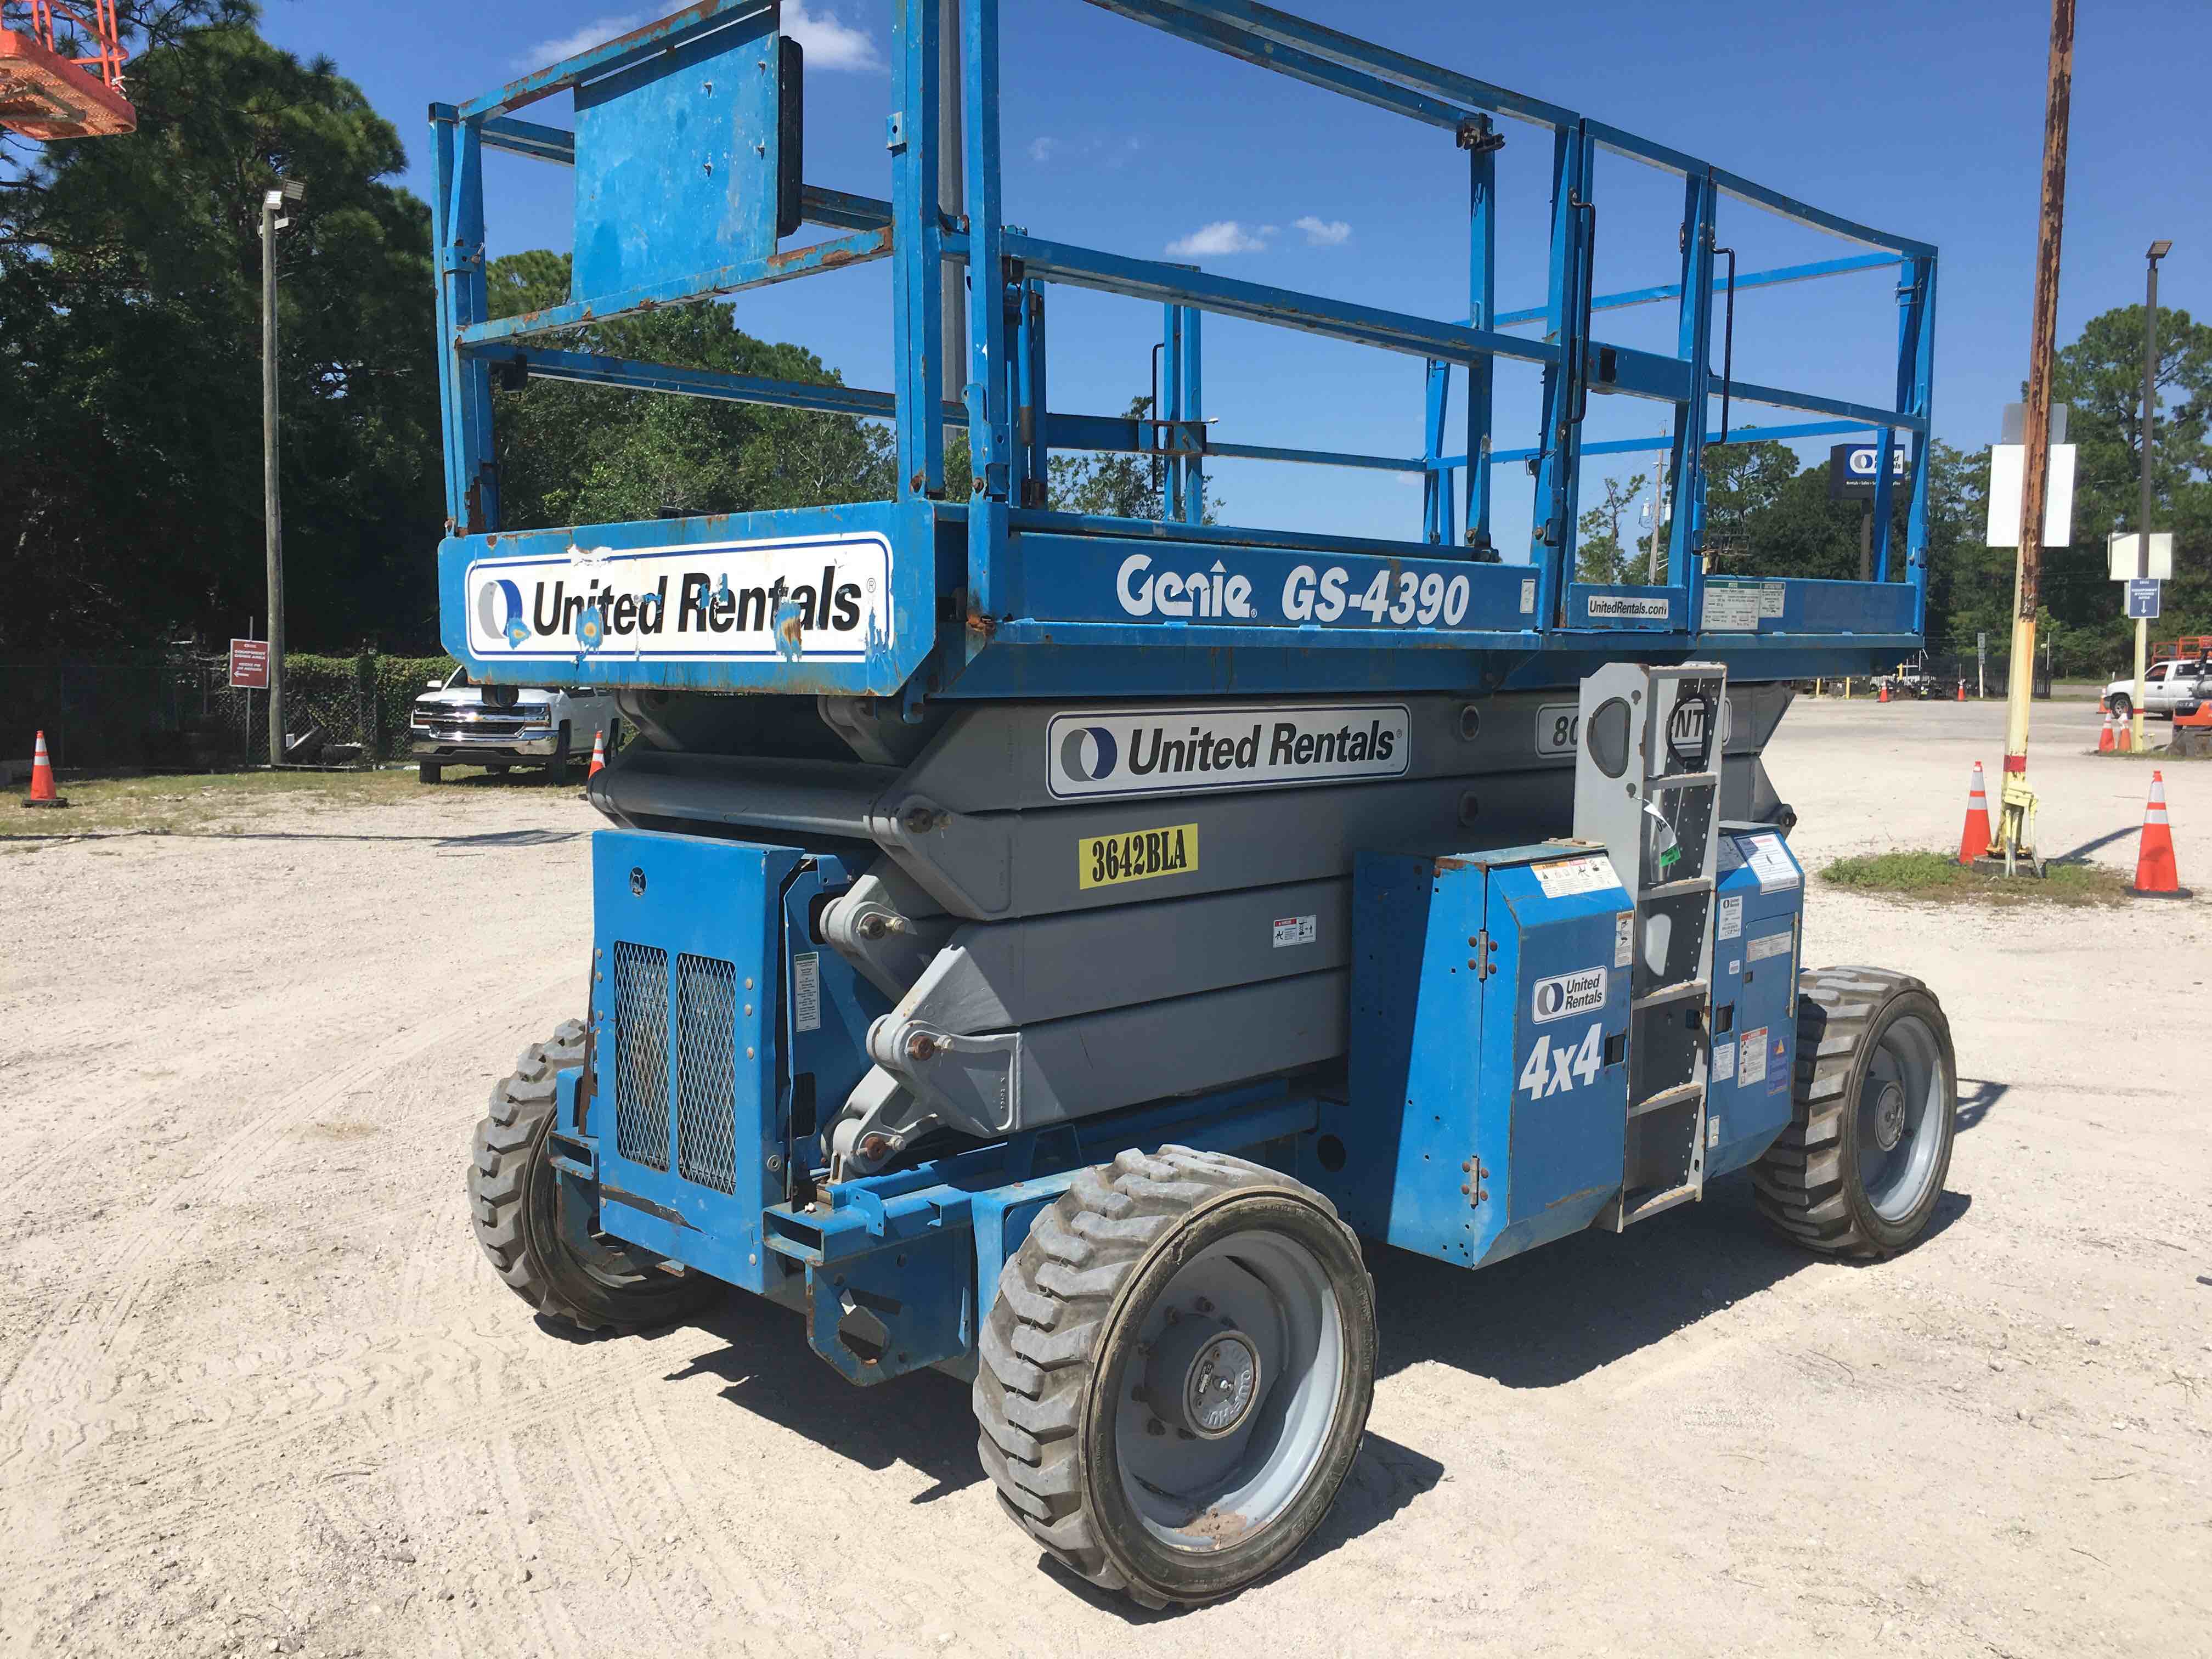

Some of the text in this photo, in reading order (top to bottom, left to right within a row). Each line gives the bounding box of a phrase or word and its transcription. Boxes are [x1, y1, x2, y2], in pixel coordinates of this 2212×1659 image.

[678, 566, 862, 633] Rentals
[1116, 554, 1470, 626] Genie GS-4390
[1589, 600, 1667, 616] UnitedRentals.com
[1128, 720, 1394, 775] United Rentals
[1092, 829, 1187, 883] 3642BLA
[1565, 989, 1602, 1010] Rentals
[1566, 974, 1601, 994] United
[1518, 1023, 1602, 1101] 4x4
